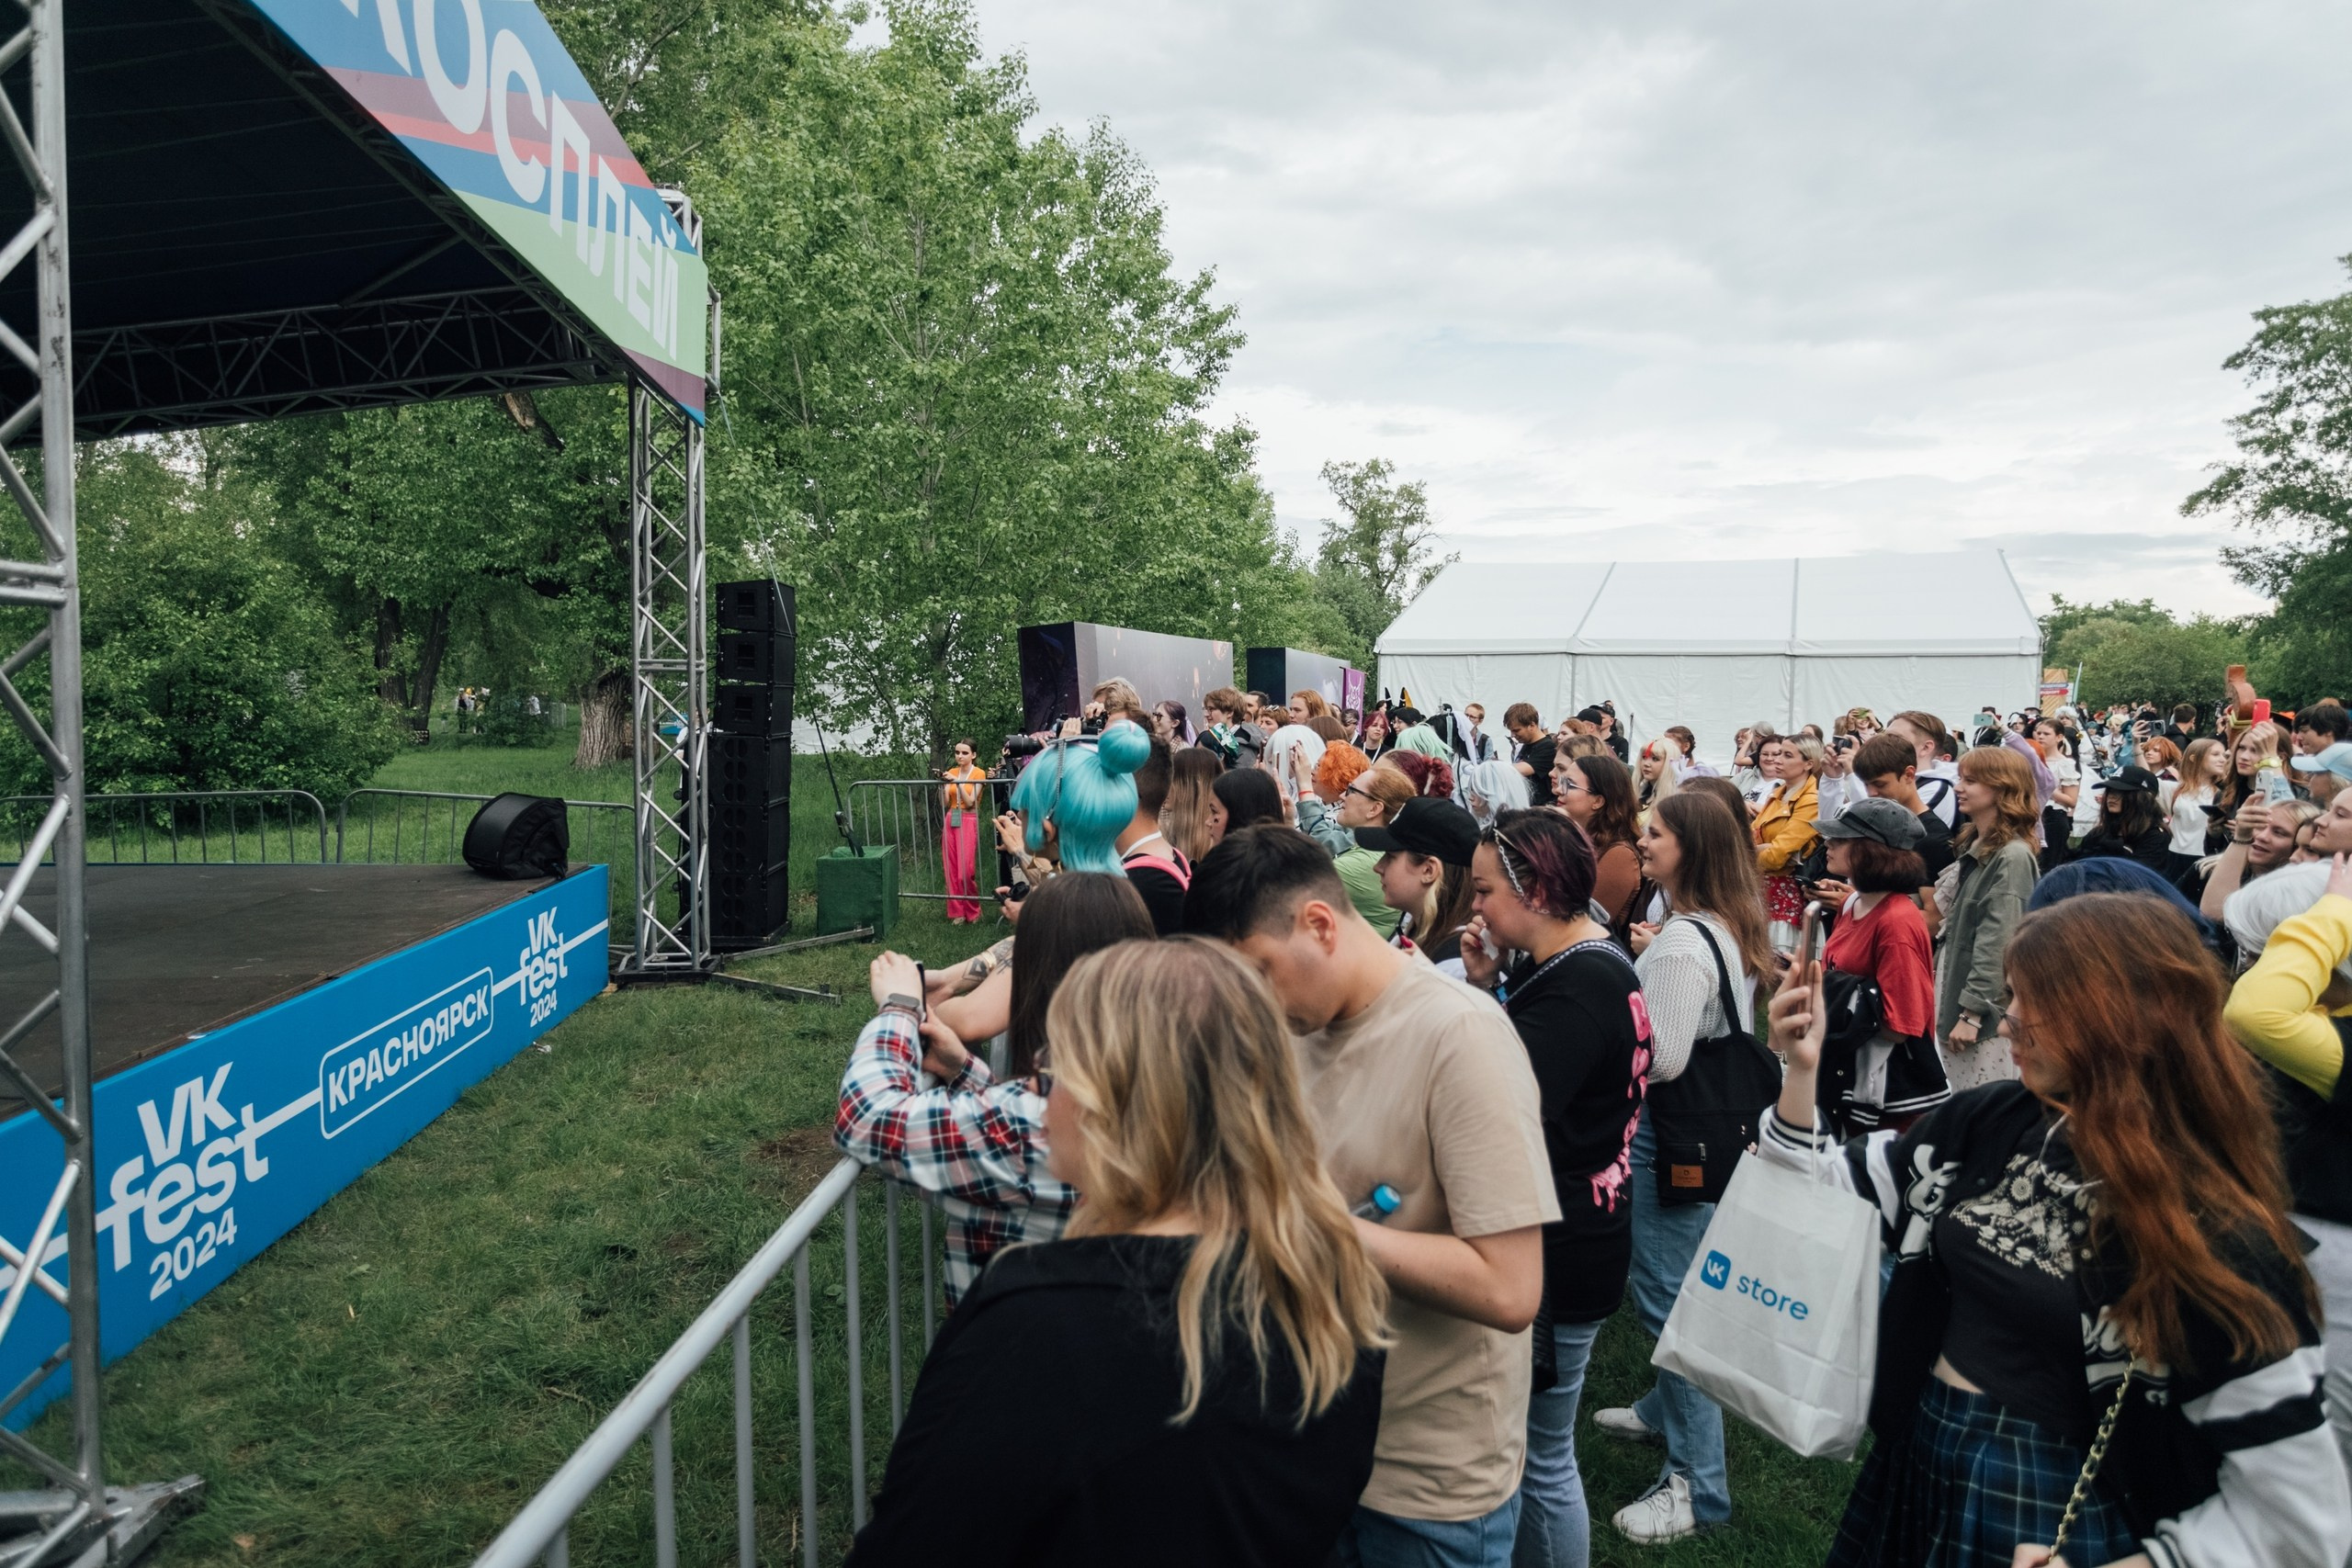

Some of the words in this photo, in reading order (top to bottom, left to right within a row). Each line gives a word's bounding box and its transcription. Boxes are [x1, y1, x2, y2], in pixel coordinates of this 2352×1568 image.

[519, 933, 568, 1006] fest
[527, 907, 559, 956] VK
[328, 985, 489, 1112] КРАСНОЯРСК
[530, 989, 558, 1027] 2024
[137, 1061, 236, 1168] VK
[107, 1103, 269, 1272] fest
[150, 1208, 237, 1302] 2024
[1707, 1258, 1724, 1281] VK
[1736, 1275, 1808, 1320] store
